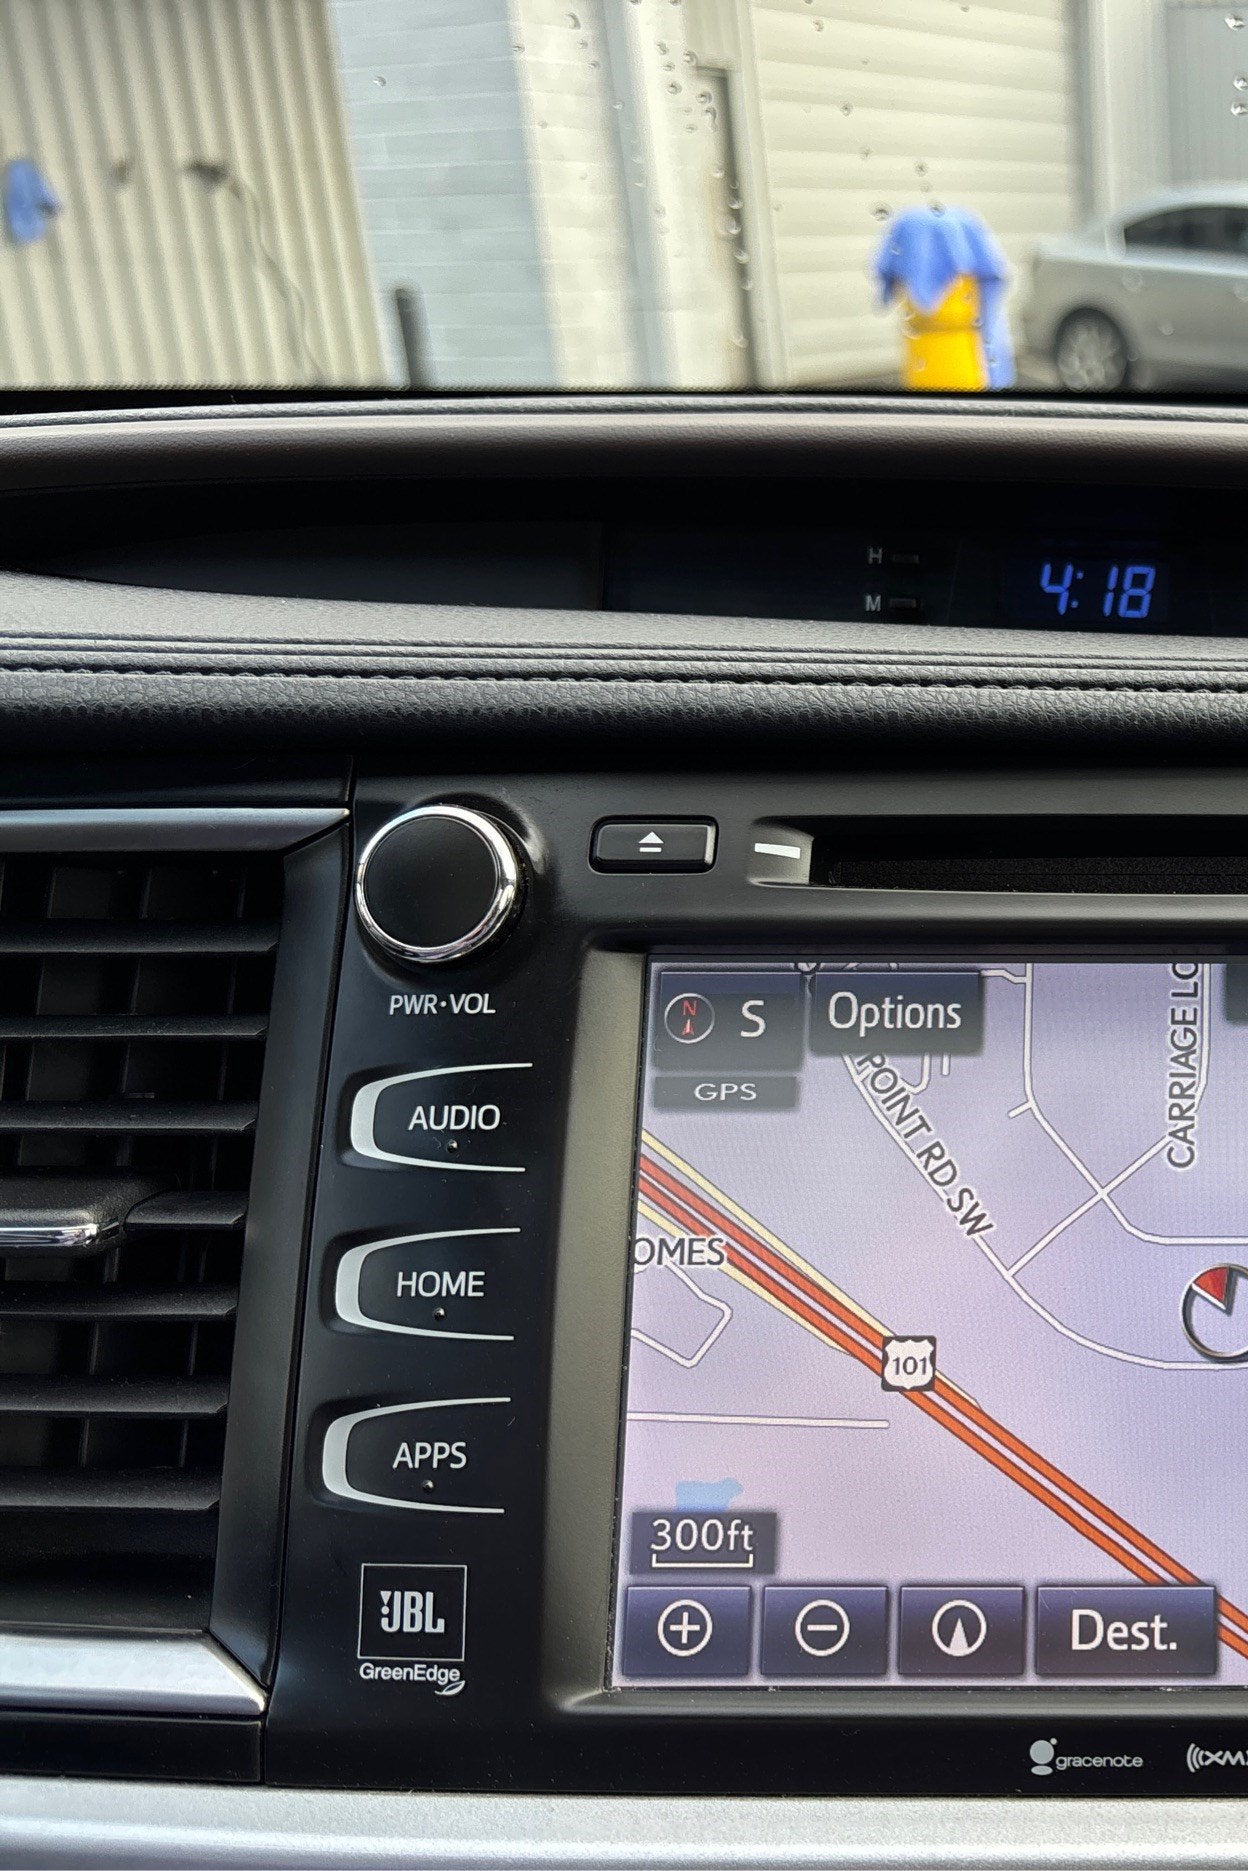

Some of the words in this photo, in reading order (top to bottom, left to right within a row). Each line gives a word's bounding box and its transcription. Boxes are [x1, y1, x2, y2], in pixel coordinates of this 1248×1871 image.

[866, 546, 883, 565] H
[865, 592, 882, 612] M
[1040, 561, 1156, 618] 4:18
[682, 999, 698, 1017] N
[740, 1000, 766, 1037] S
[828, 991, 962, 1037] Options
[694, 1083, 757, 1101] GPS
[1166, 1007, 1198, 1169] CARRIAGE
[408, 1104, 501, 1131] AUDIO
[856, 1053, 932, 1139] POINT
[916, 1140, 958, 1187] RD
[946, 1187, 994, 1236] SW
[634, 1237, 725, 1266] OMES
[396, 1271, 486, 1297] HOME
[891, 1354, 928, 1377] 101
[392, 1442, 468, 1469] APPS
[651, 1518, 754, 1552] 300ft
[380, 1590, 446, 1634] JBL
[1070, 1608, 1178, 1651] Dest.
[358, 1663, 462, 1685] GreenEdge
[1055, 1753, 1144, 1769] gracenote
